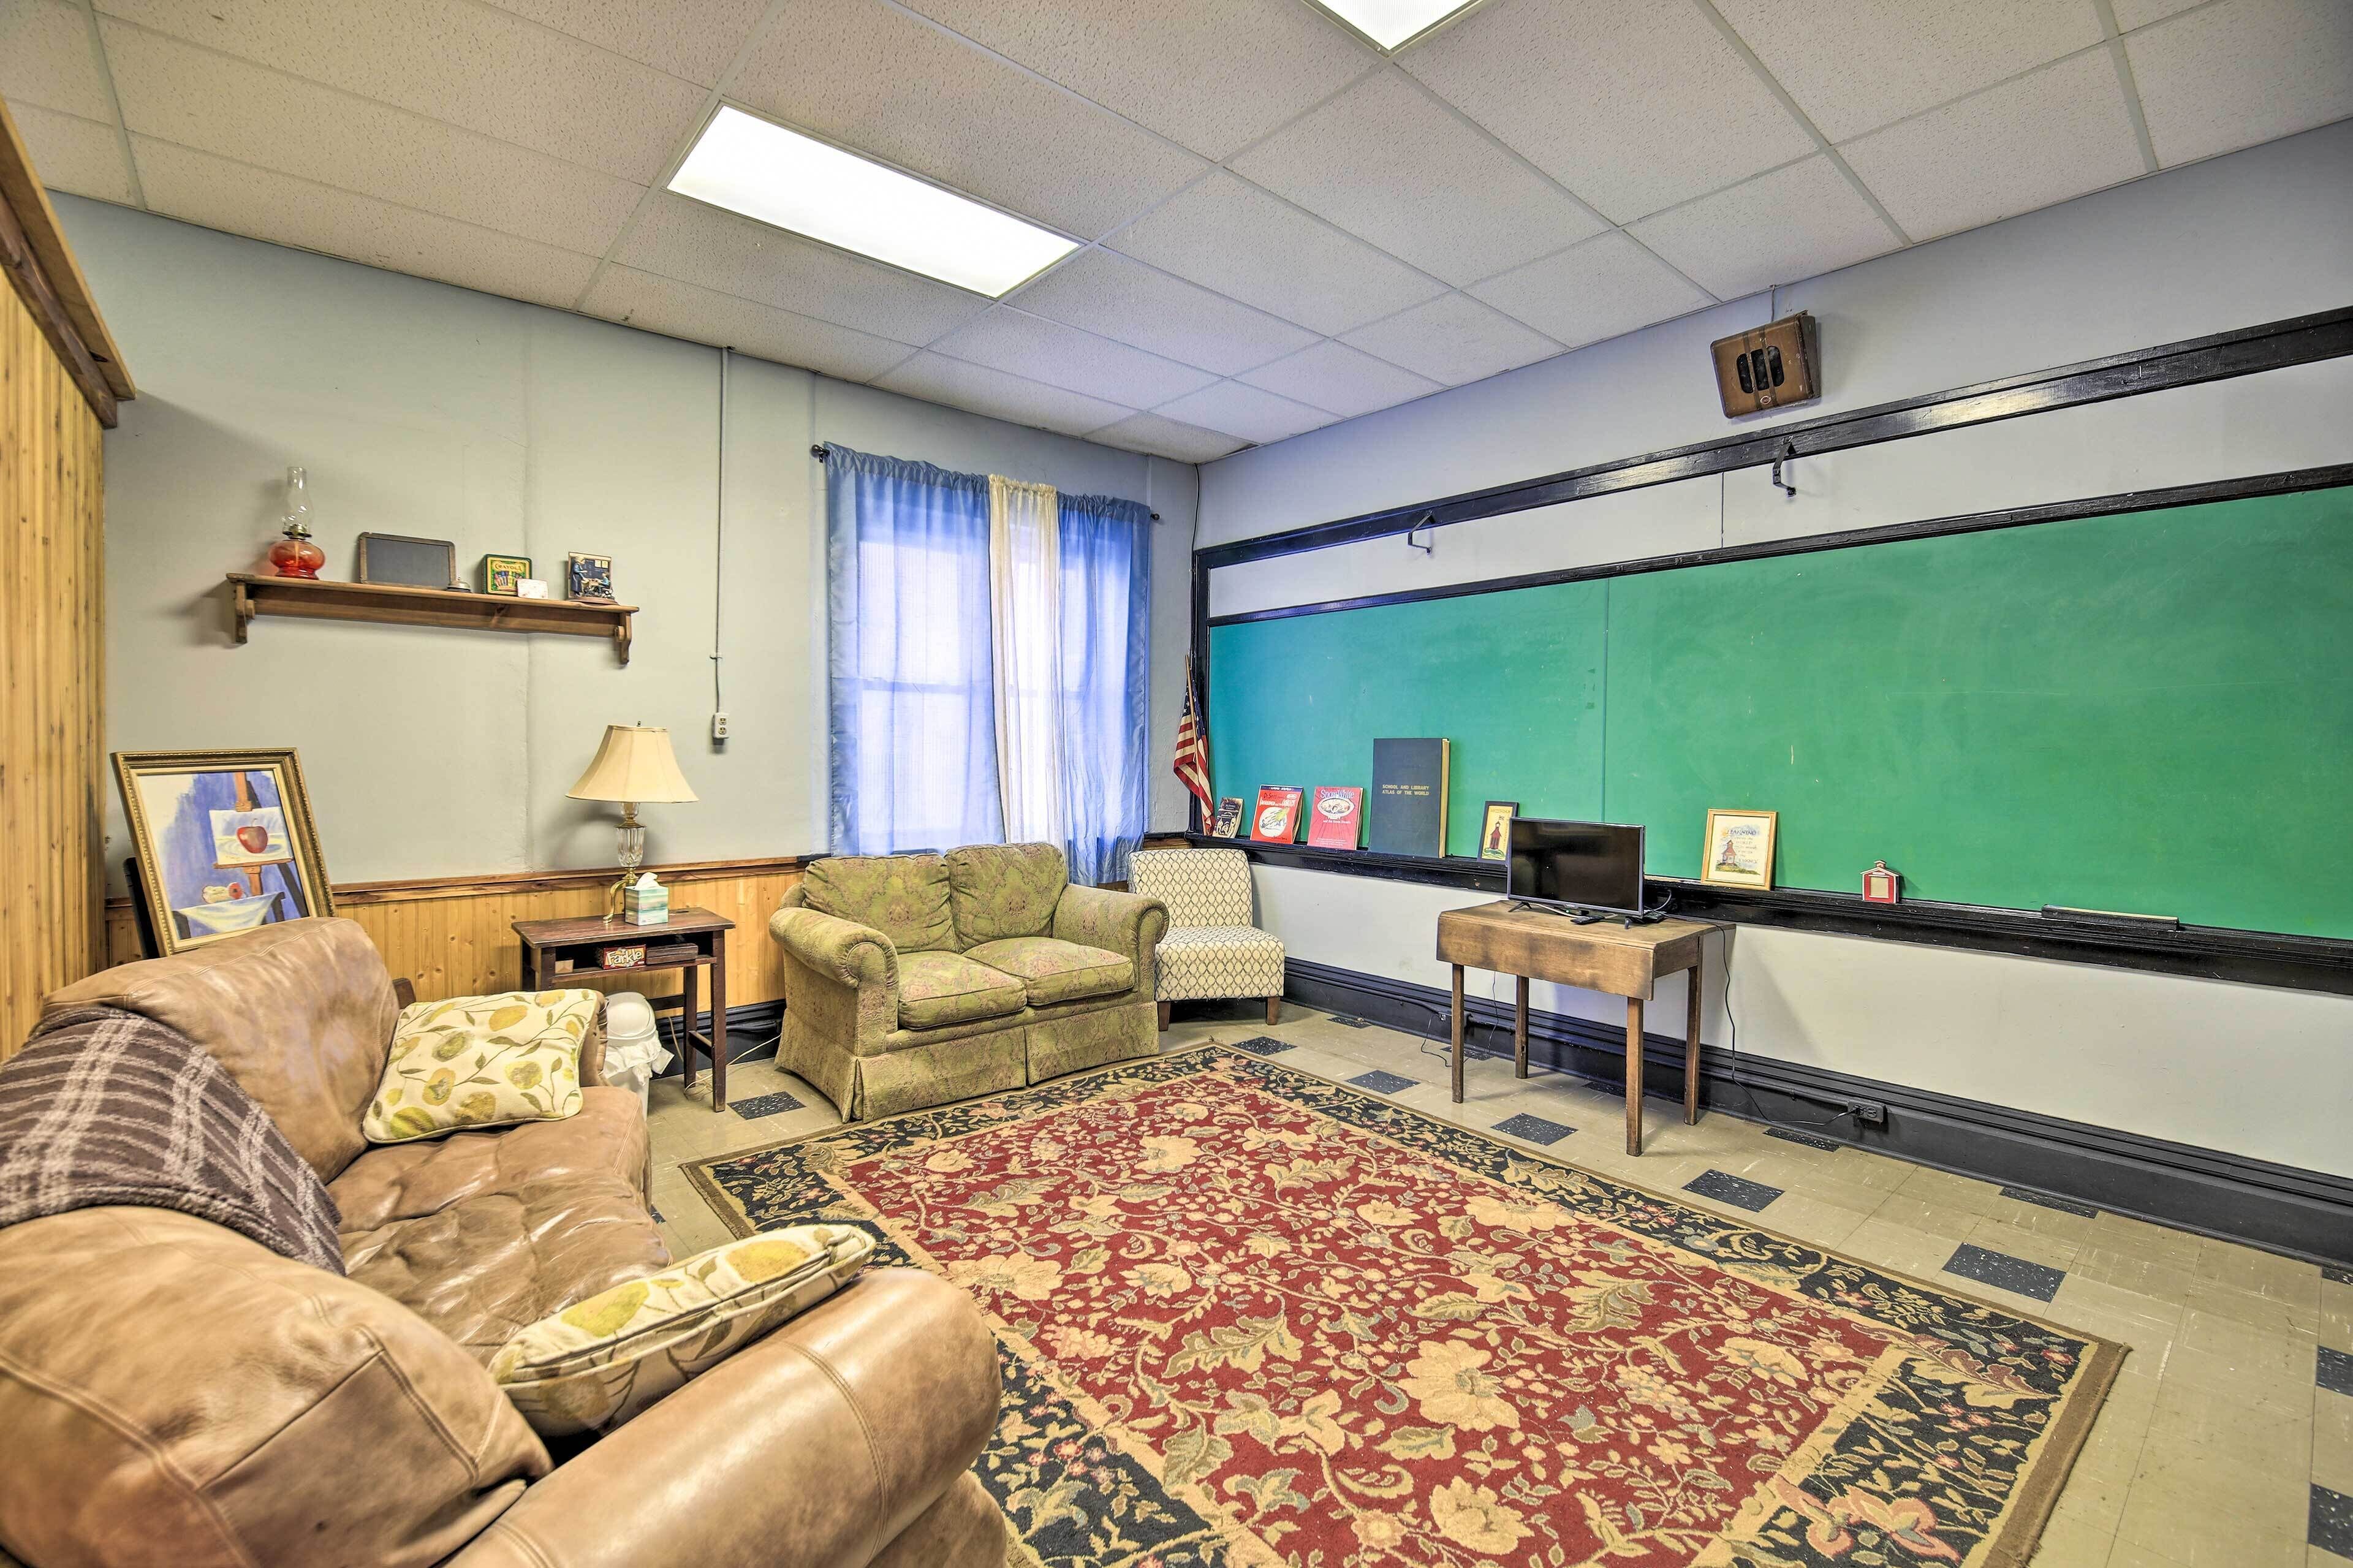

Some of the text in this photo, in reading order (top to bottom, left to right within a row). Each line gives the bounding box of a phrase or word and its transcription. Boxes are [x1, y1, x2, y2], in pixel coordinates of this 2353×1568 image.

[494, 563, 523, 572] CRAYOLA
[1320, 789, 1354, 798] Snow White
[606, 949, 642, 966] Farkle
